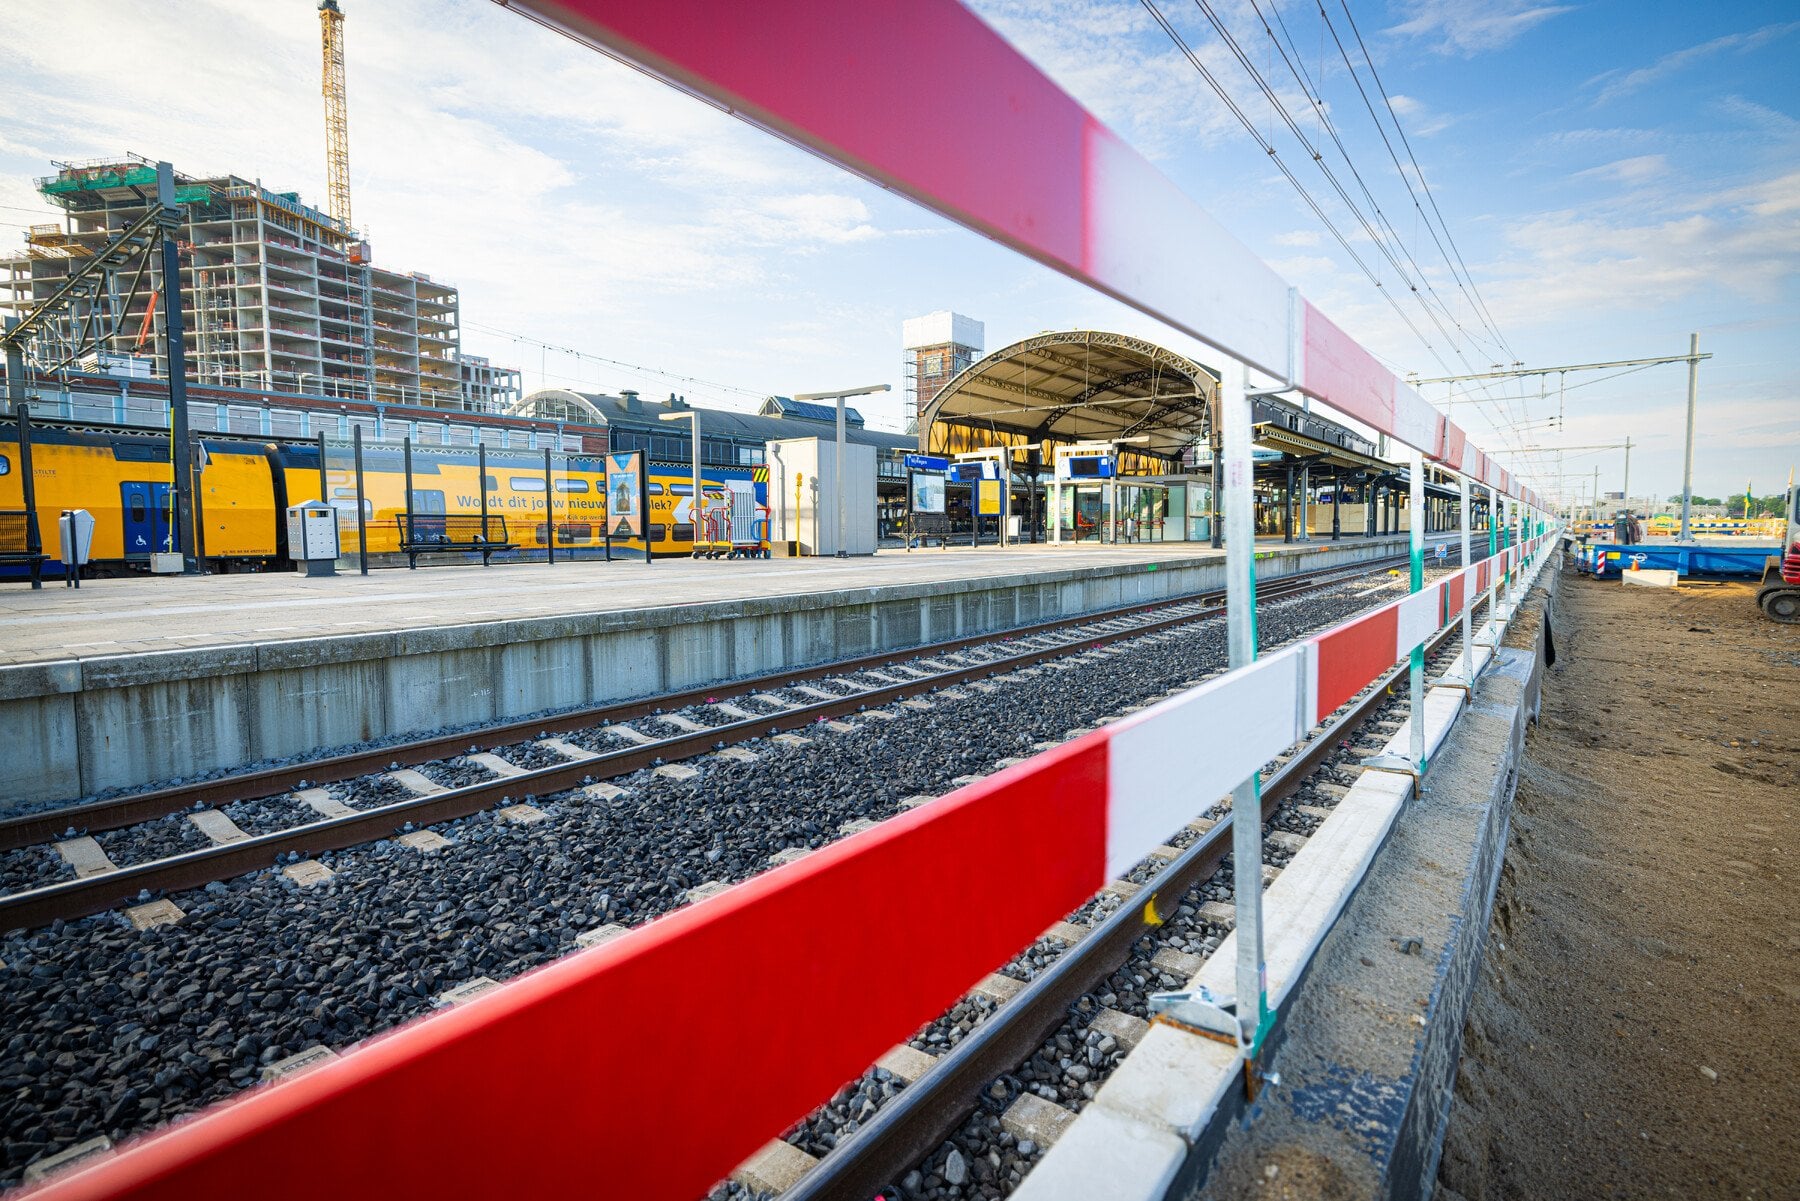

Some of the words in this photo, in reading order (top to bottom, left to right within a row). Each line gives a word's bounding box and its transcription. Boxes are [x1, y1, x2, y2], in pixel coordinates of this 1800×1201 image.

[456, 495, 504, 507] Wodt
[508, 496, 527, 508] dit
[531, 496, 564, 511] jow
[667, 523, 672, 531] 2
